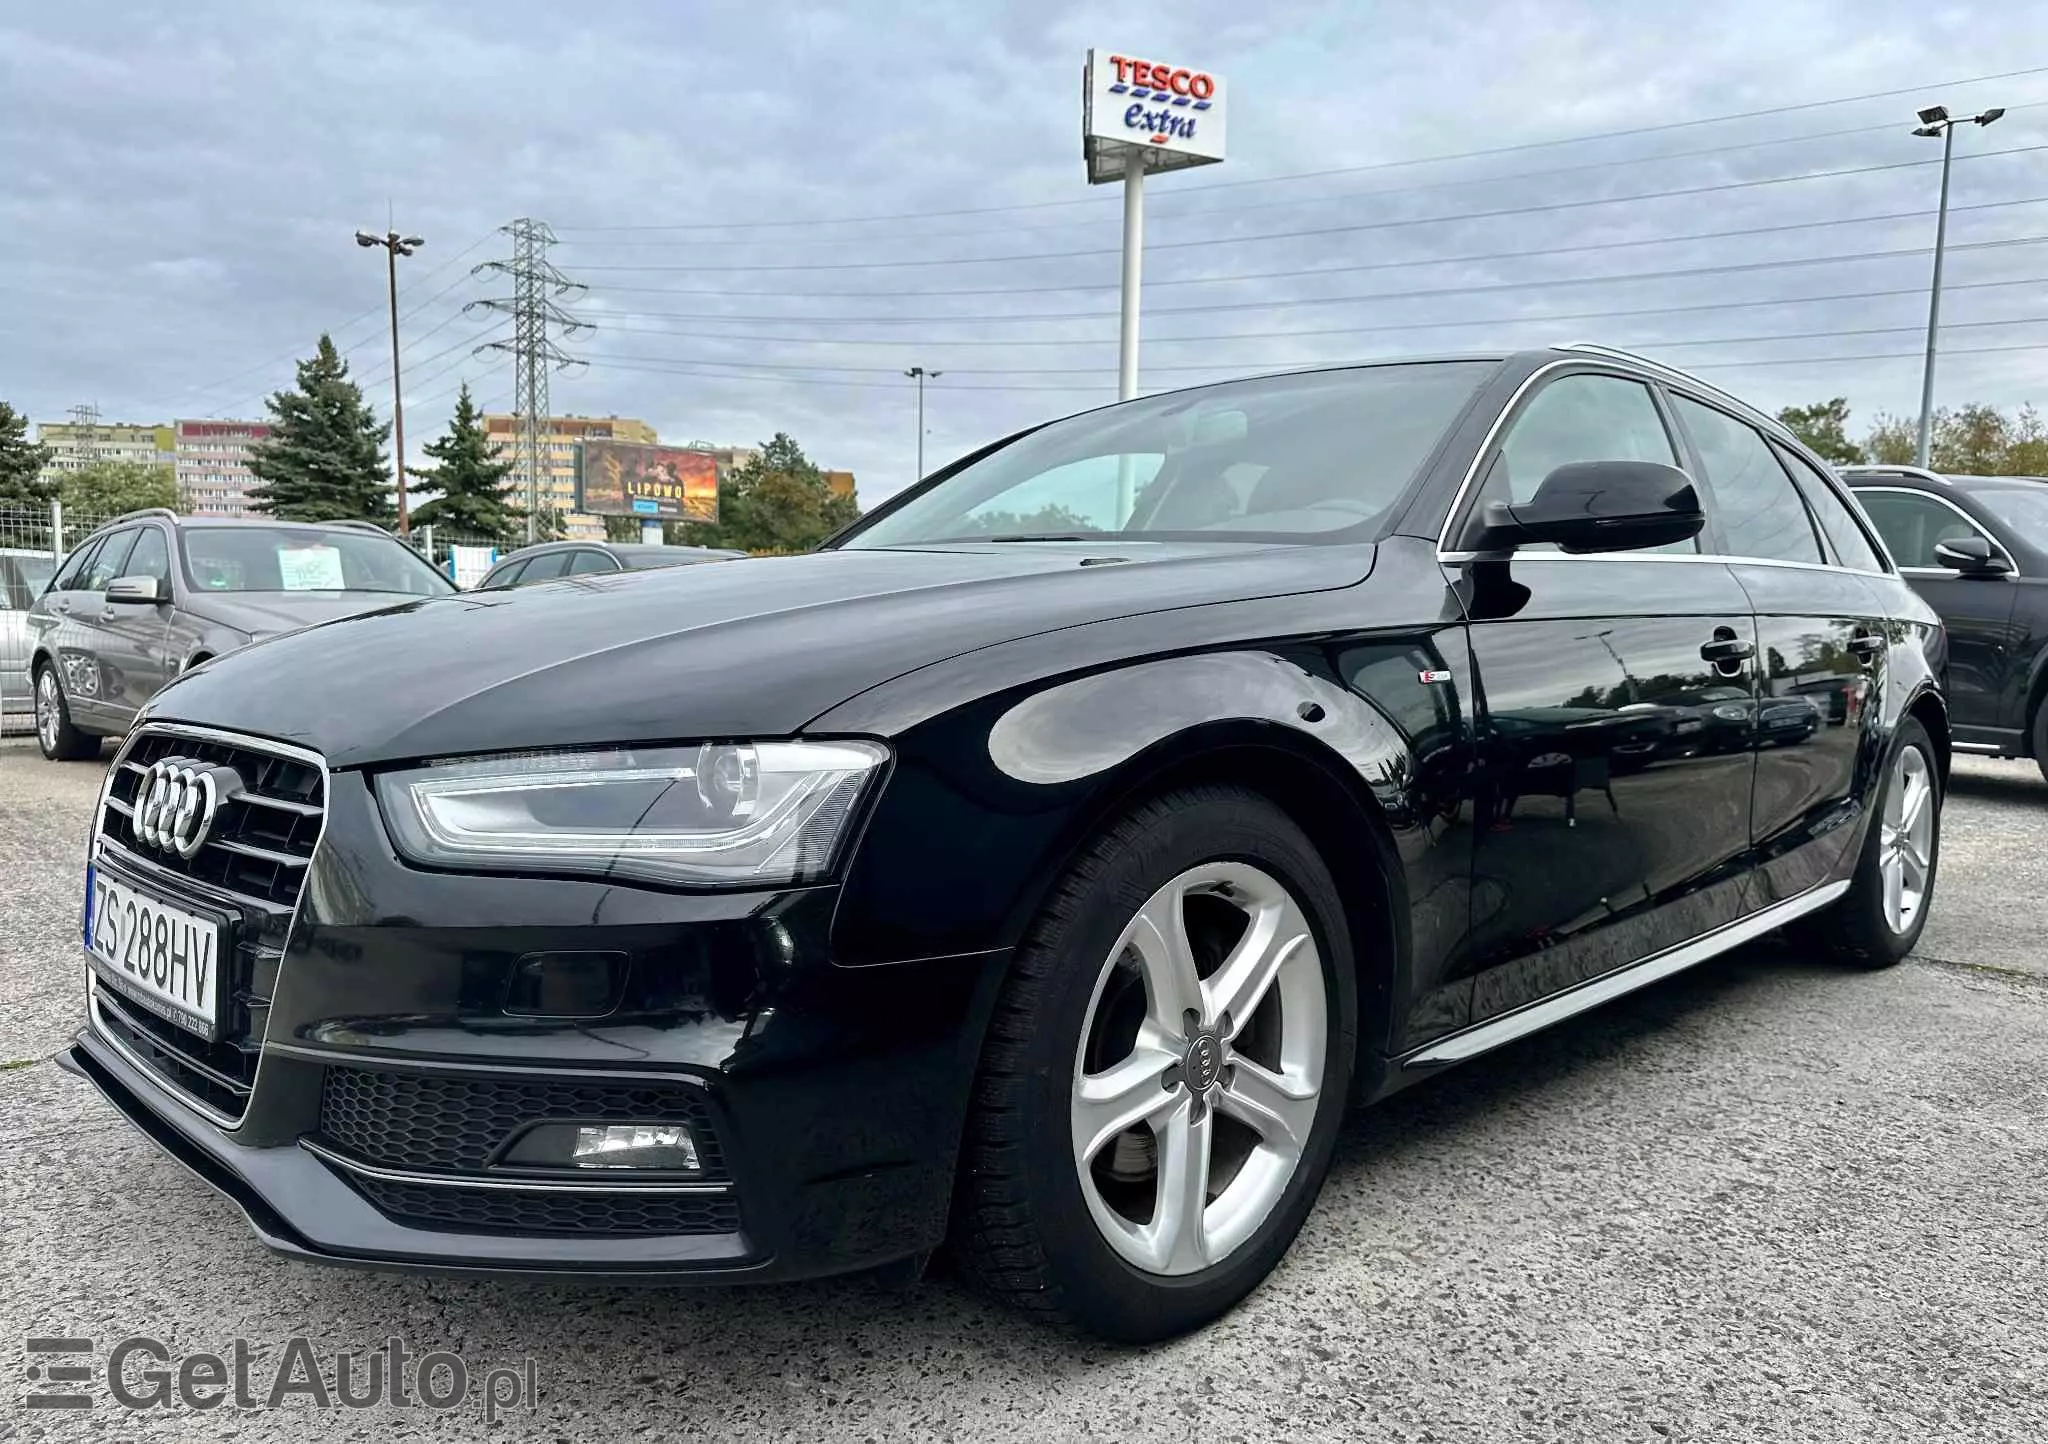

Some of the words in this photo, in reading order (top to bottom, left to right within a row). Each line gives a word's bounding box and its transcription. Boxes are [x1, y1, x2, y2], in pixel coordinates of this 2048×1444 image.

[1109, 55, 1214, 99] TESCO
[1124, 102, 1197, 138] extra
[627, 481, 682, 499] LIPOWO
[95, 880, 119, 959] ZS
[124, 900, 211, 1007] 288HV
